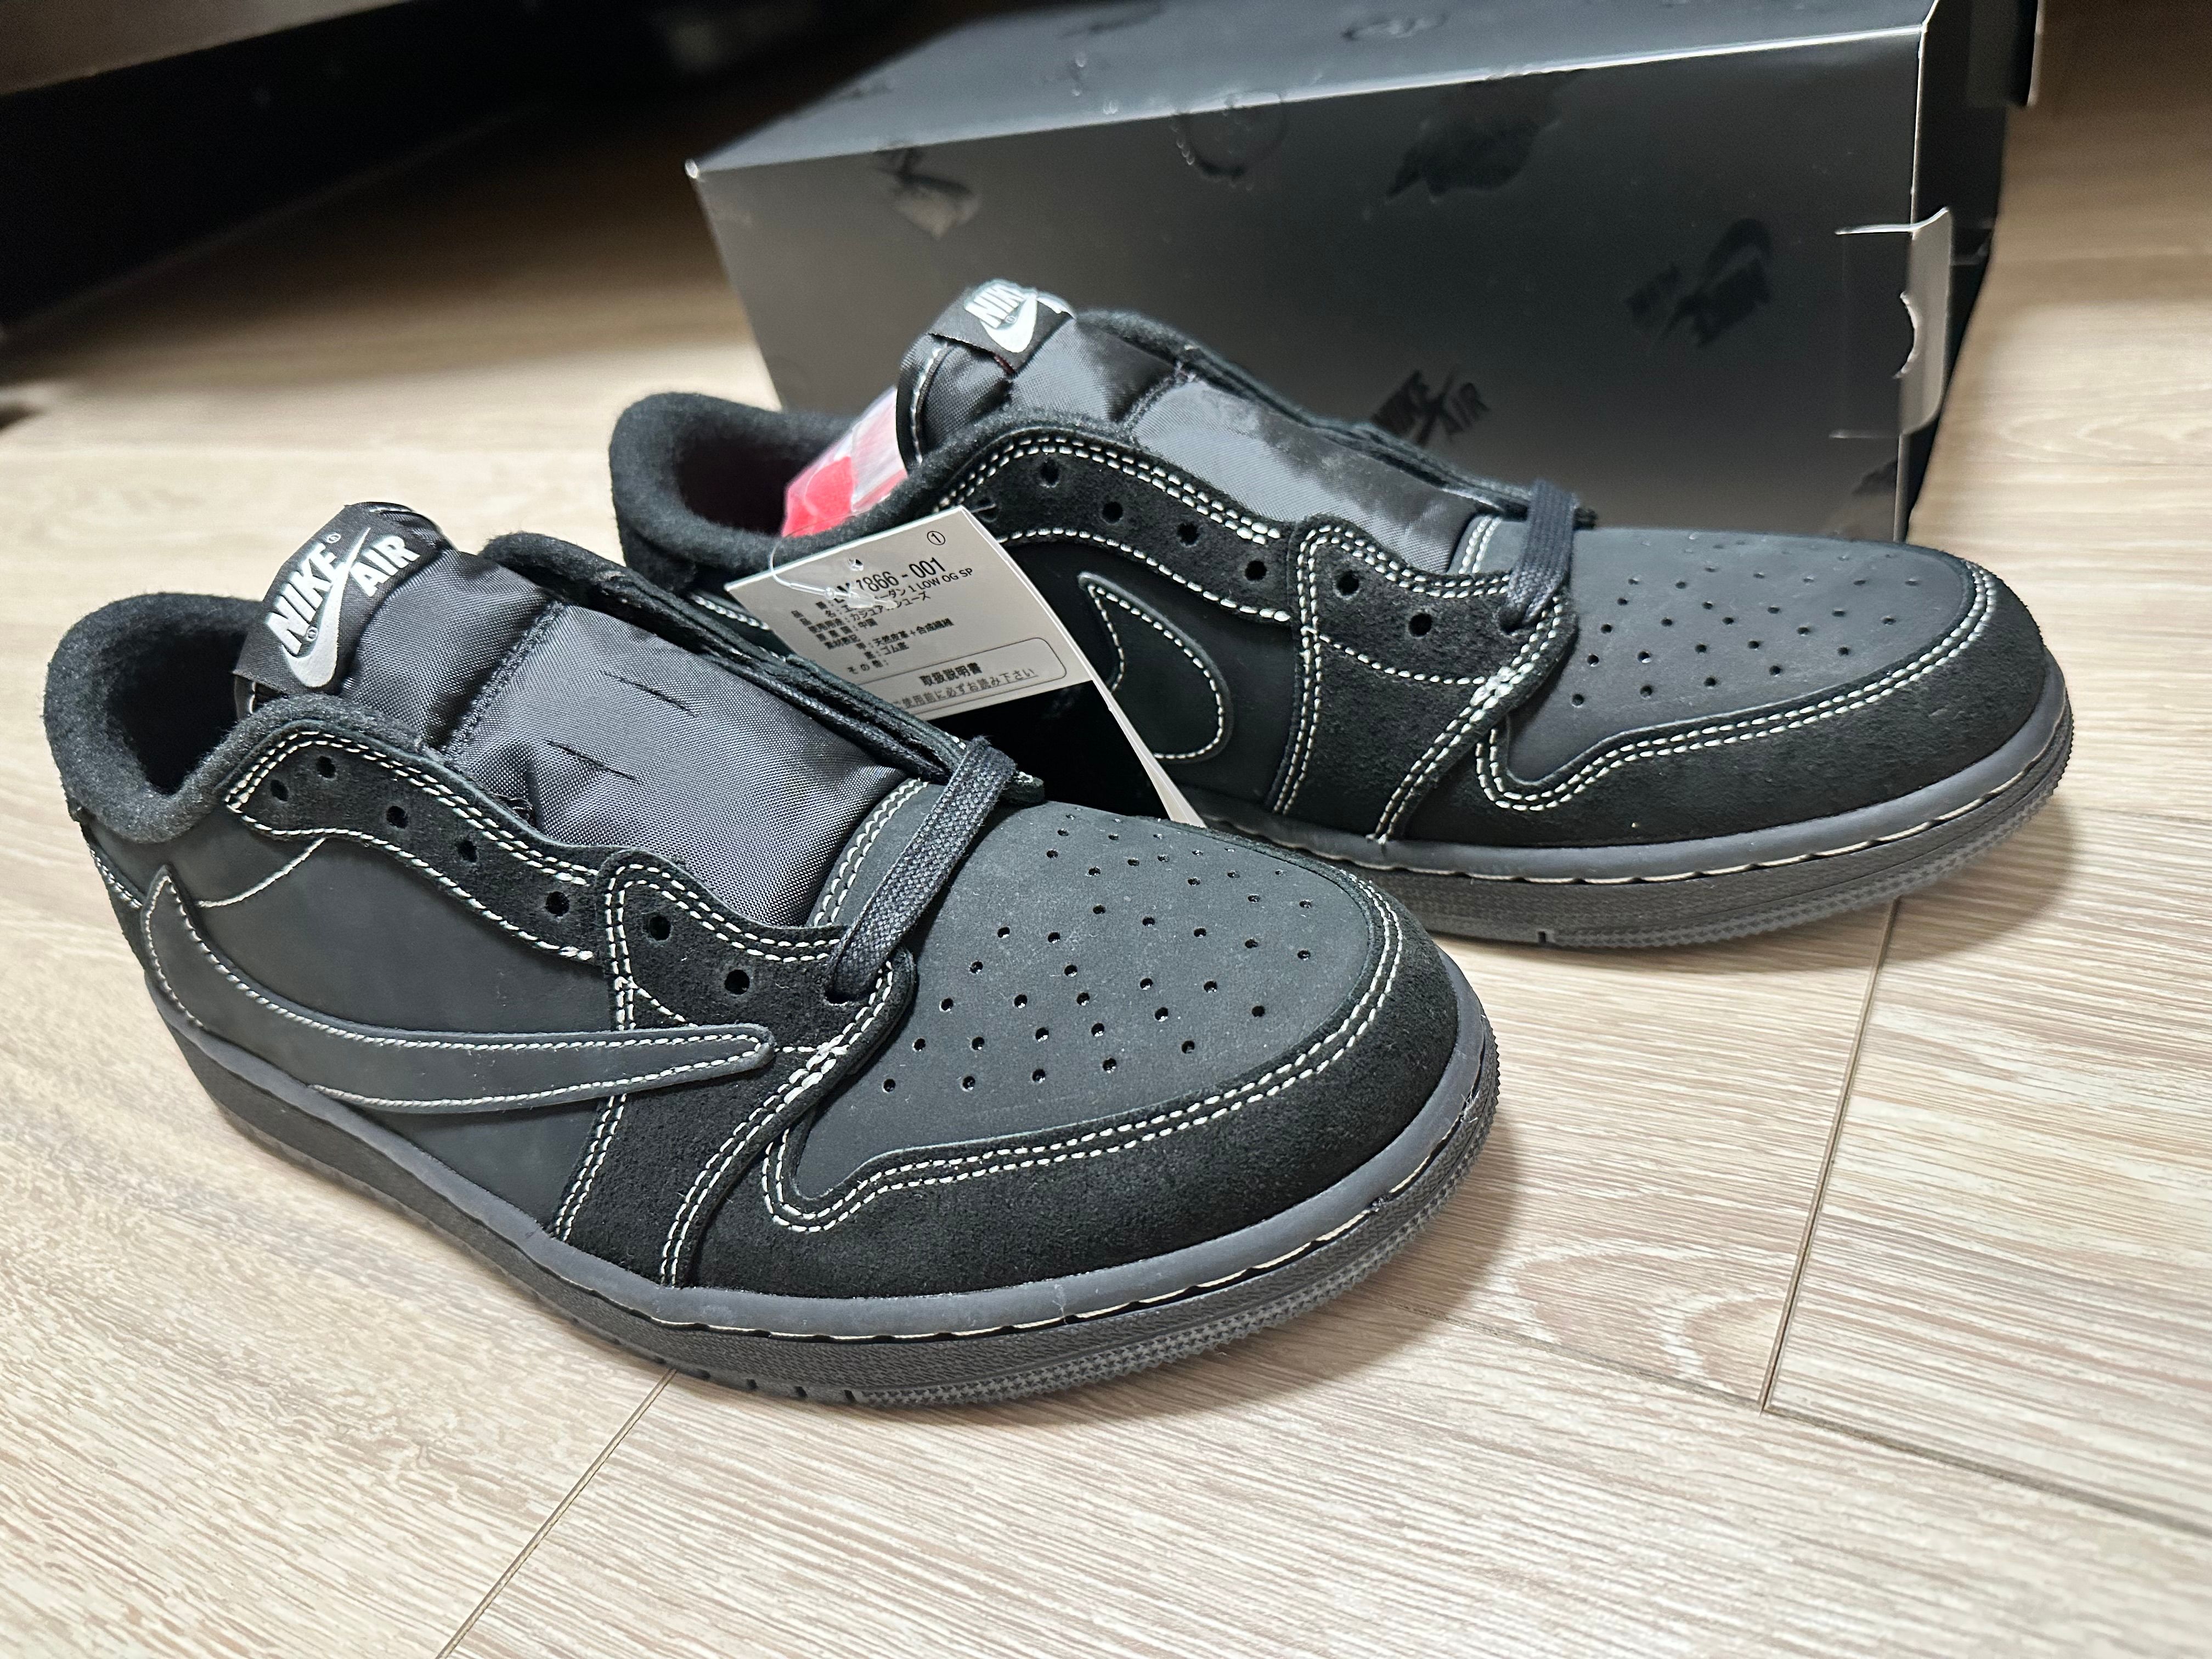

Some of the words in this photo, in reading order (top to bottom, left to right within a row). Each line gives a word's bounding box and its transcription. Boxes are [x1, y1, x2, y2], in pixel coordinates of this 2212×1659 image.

[909, 557, 946, 578] 001
[916, 577, 940, 590] LOW
[941, 572, 959, 582] OG
[958, 567, 973, 577] SP
[266, 542, 337, 655] NIKE
[349, 535, 421, 597] AIR
[919, 662, 983, 686] 取扱説明書
